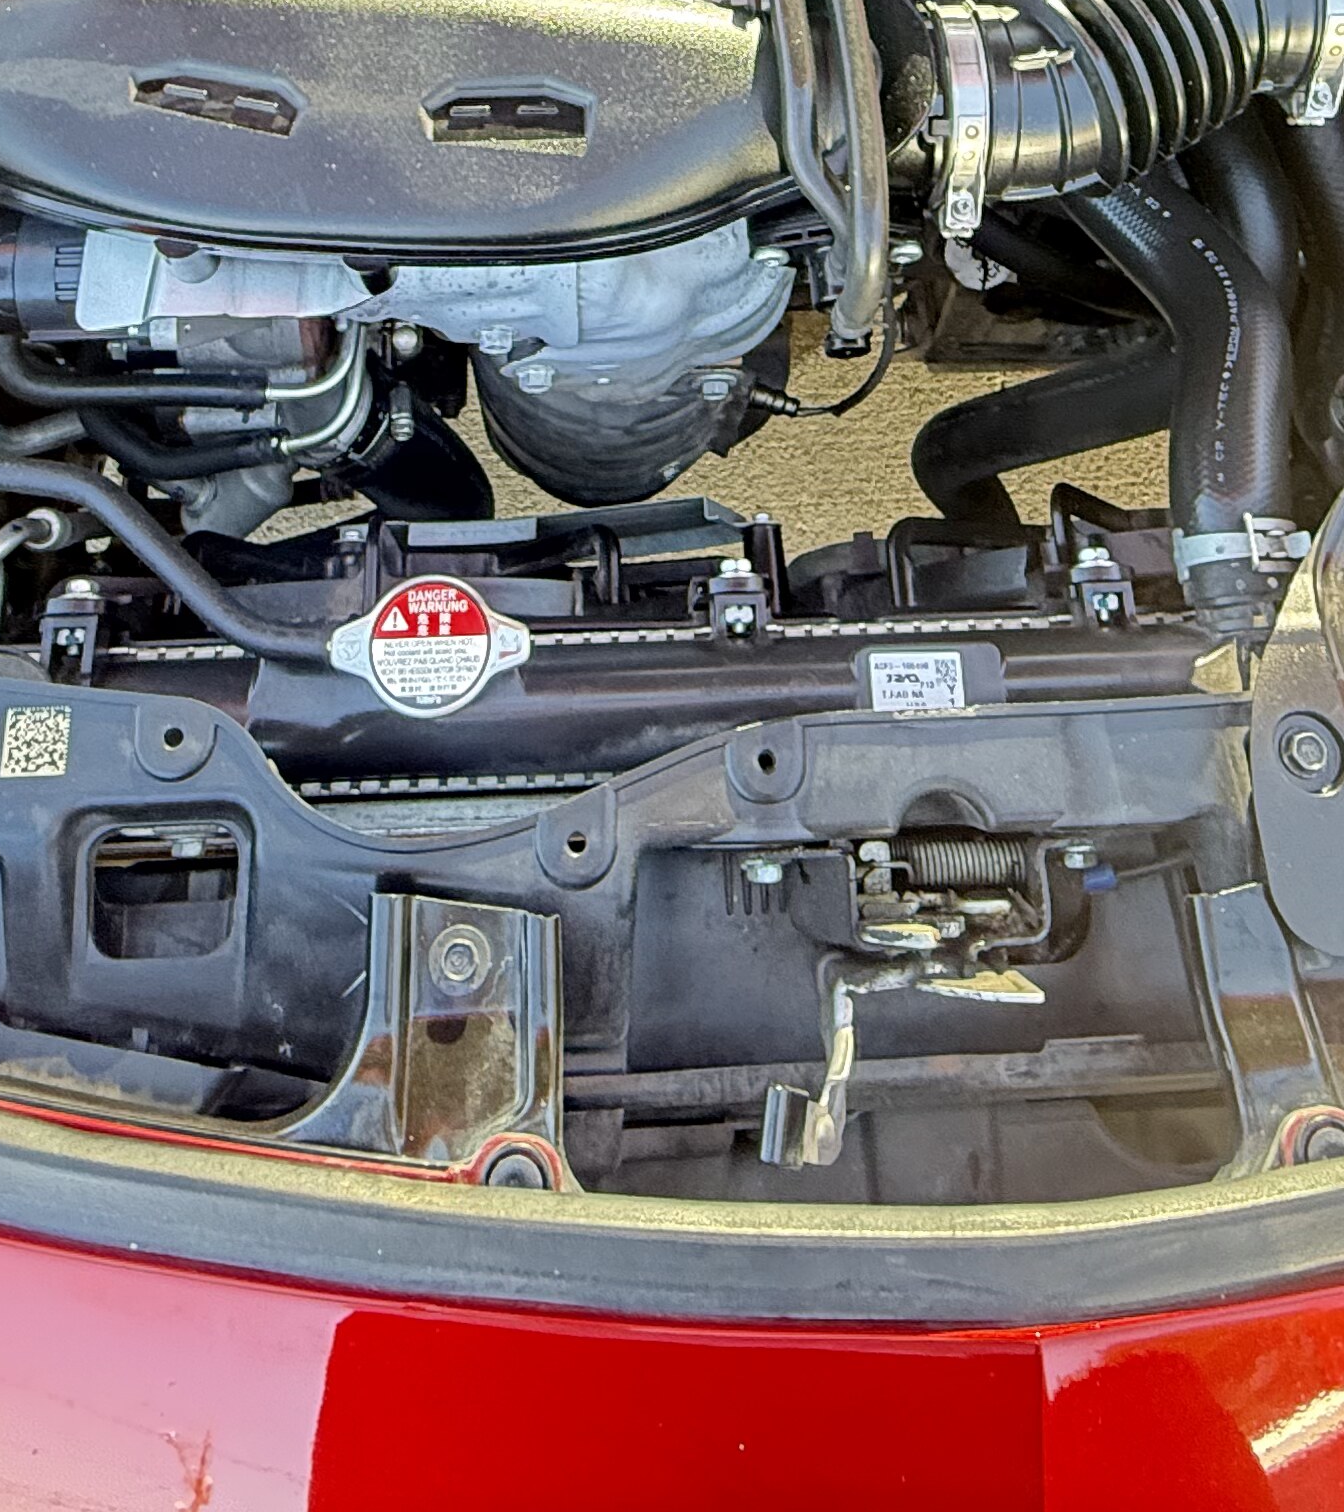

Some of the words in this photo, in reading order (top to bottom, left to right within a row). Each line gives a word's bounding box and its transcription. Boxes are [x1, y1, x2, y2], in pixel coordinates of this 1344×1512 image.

[407, 588, 457, 602] DANGER
[407, 599, 469, 615] WARNUNG
[384, 640, 410, 649] NEVER
[411, 639, 432, 647] OPEN
[434, 638, 457, 646] WHEN
[413, 656, 428, 665] PAS
